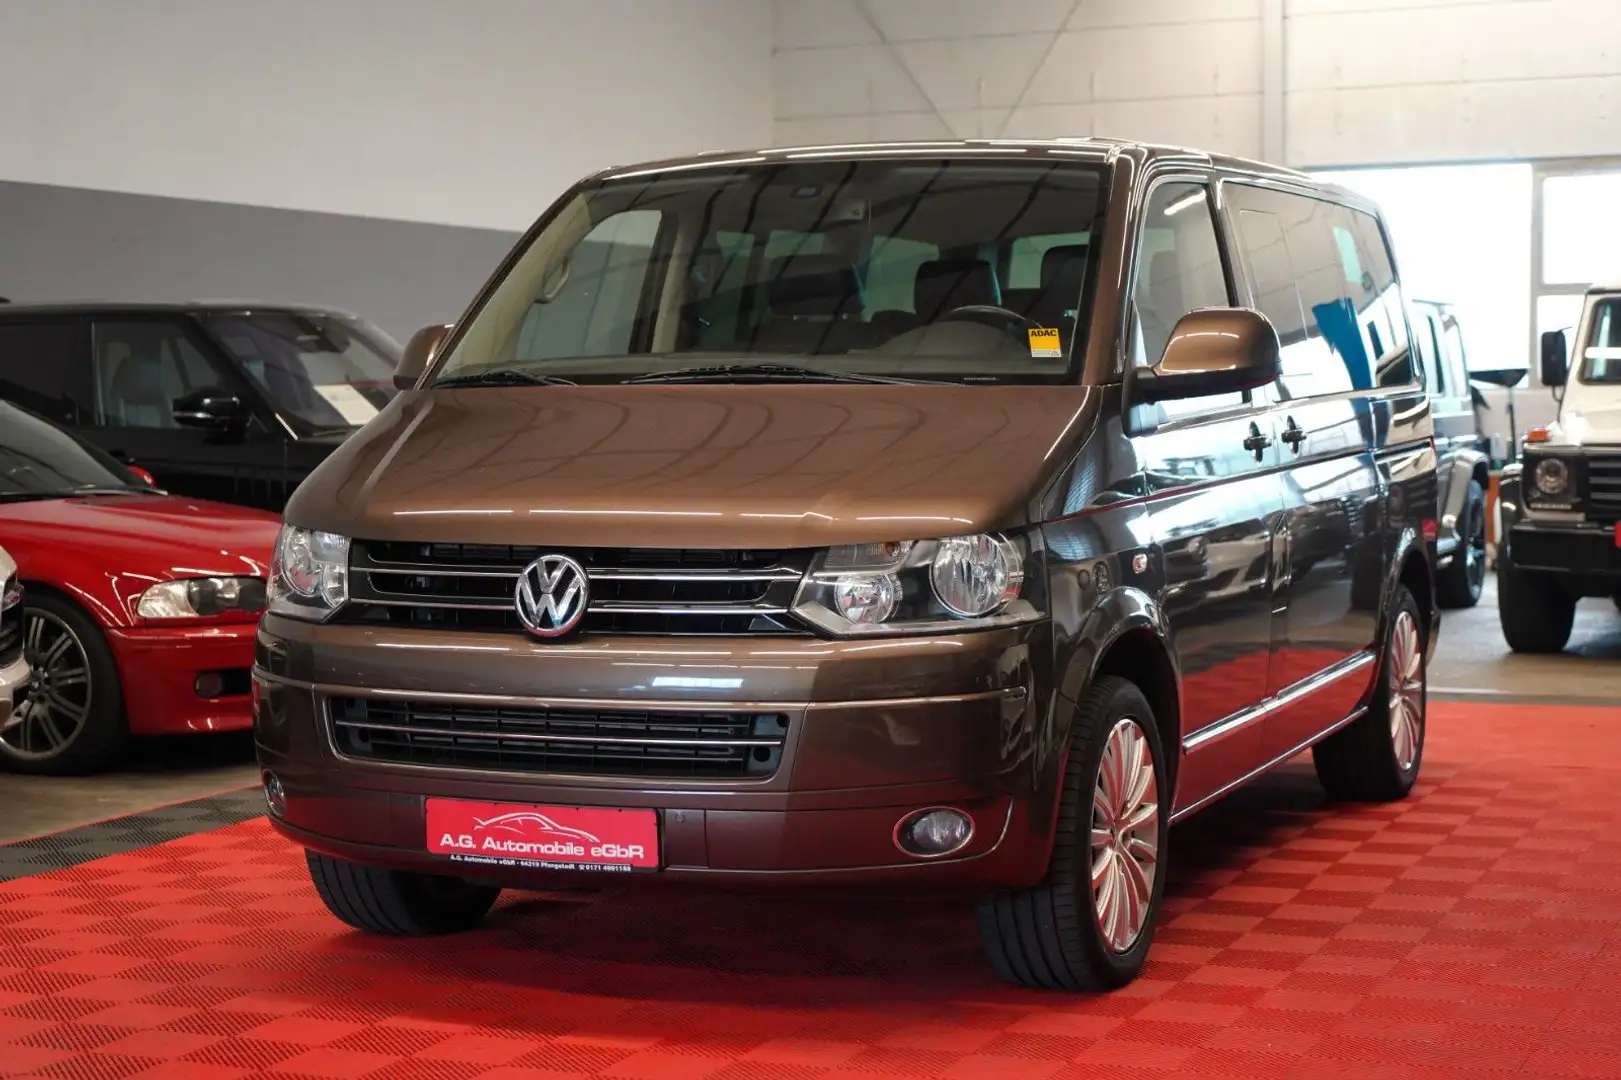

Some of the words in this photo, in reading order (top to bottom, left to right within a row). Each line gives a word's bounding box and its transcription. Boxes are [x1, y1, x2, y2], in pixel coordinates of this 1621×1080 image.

[1030, 329, 1057, 337] ADAC
[440, 833, 476, 848] A.G.
[482, 837, 584, 854] Automobile
[591, 843, 644, 859] eGbR
[464, 855, 498, 865] Automobile
[541, 861, 575, 870] Pfungstadt
